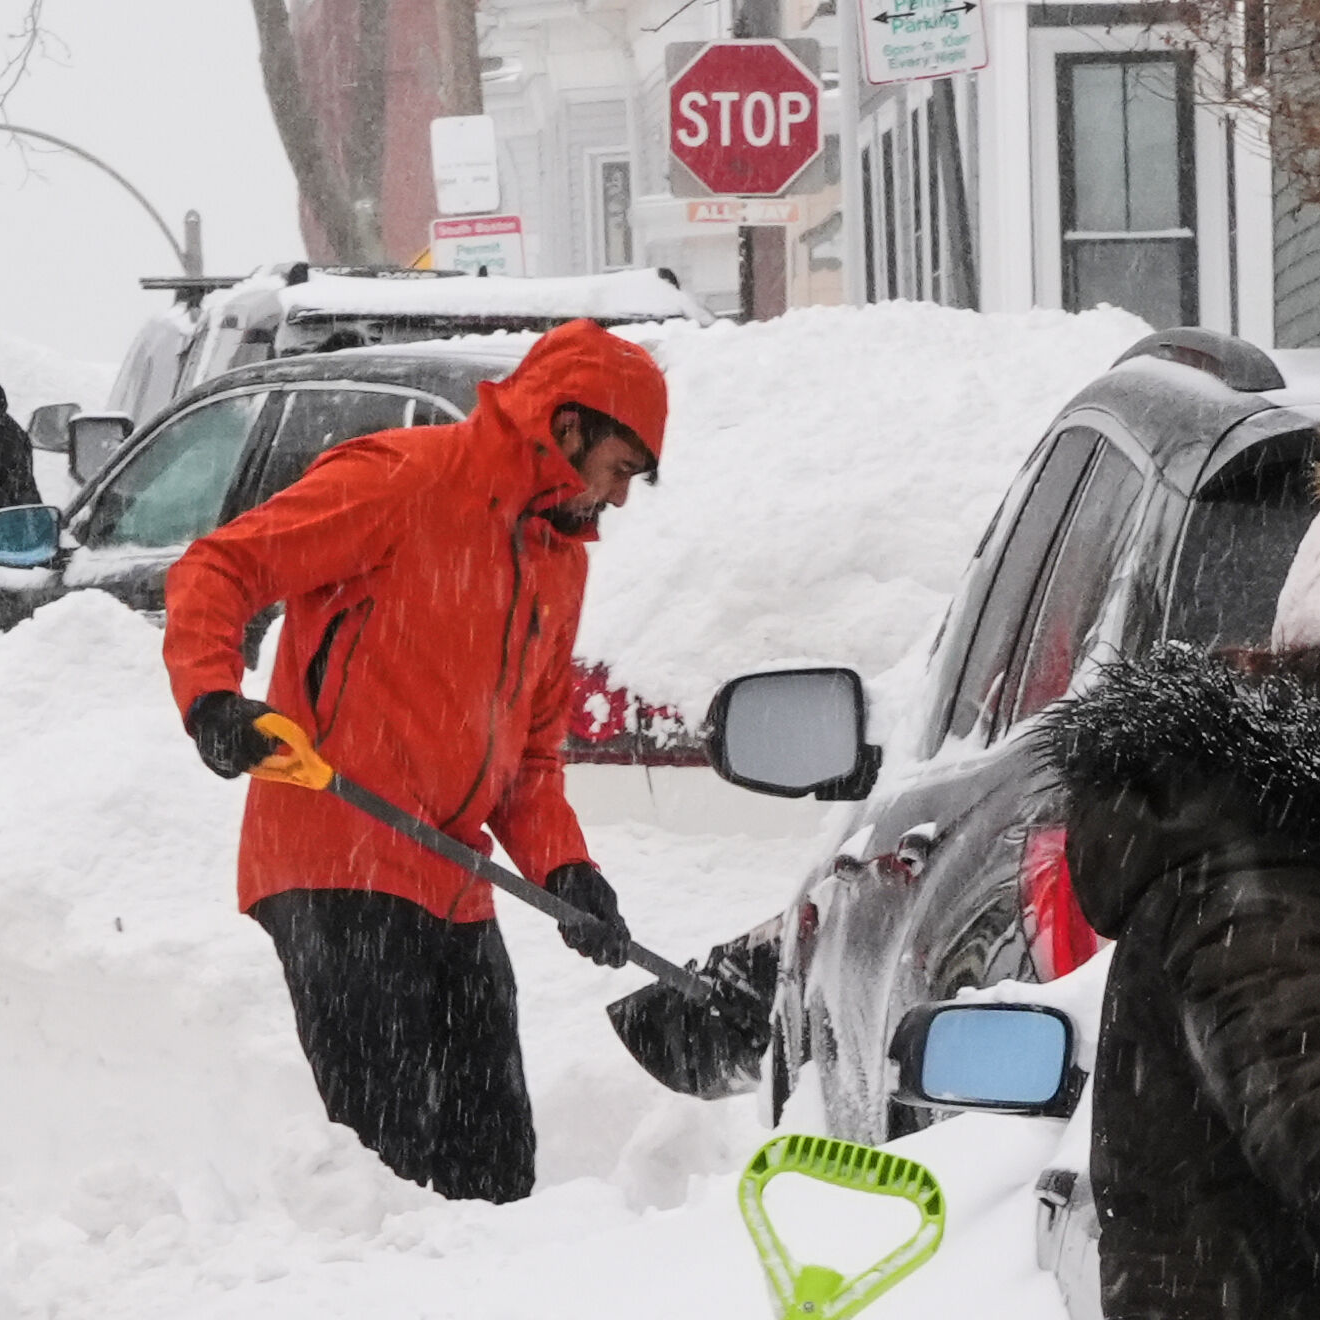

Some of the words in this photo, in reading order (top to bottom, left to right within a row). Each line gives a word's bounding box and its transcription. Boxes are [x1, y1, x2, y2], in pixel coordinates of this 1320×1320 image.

[892, 12, 960, 34] Parking
[676, 91, 811, 147] STOP
[455, 242, 501, 257] Permit
